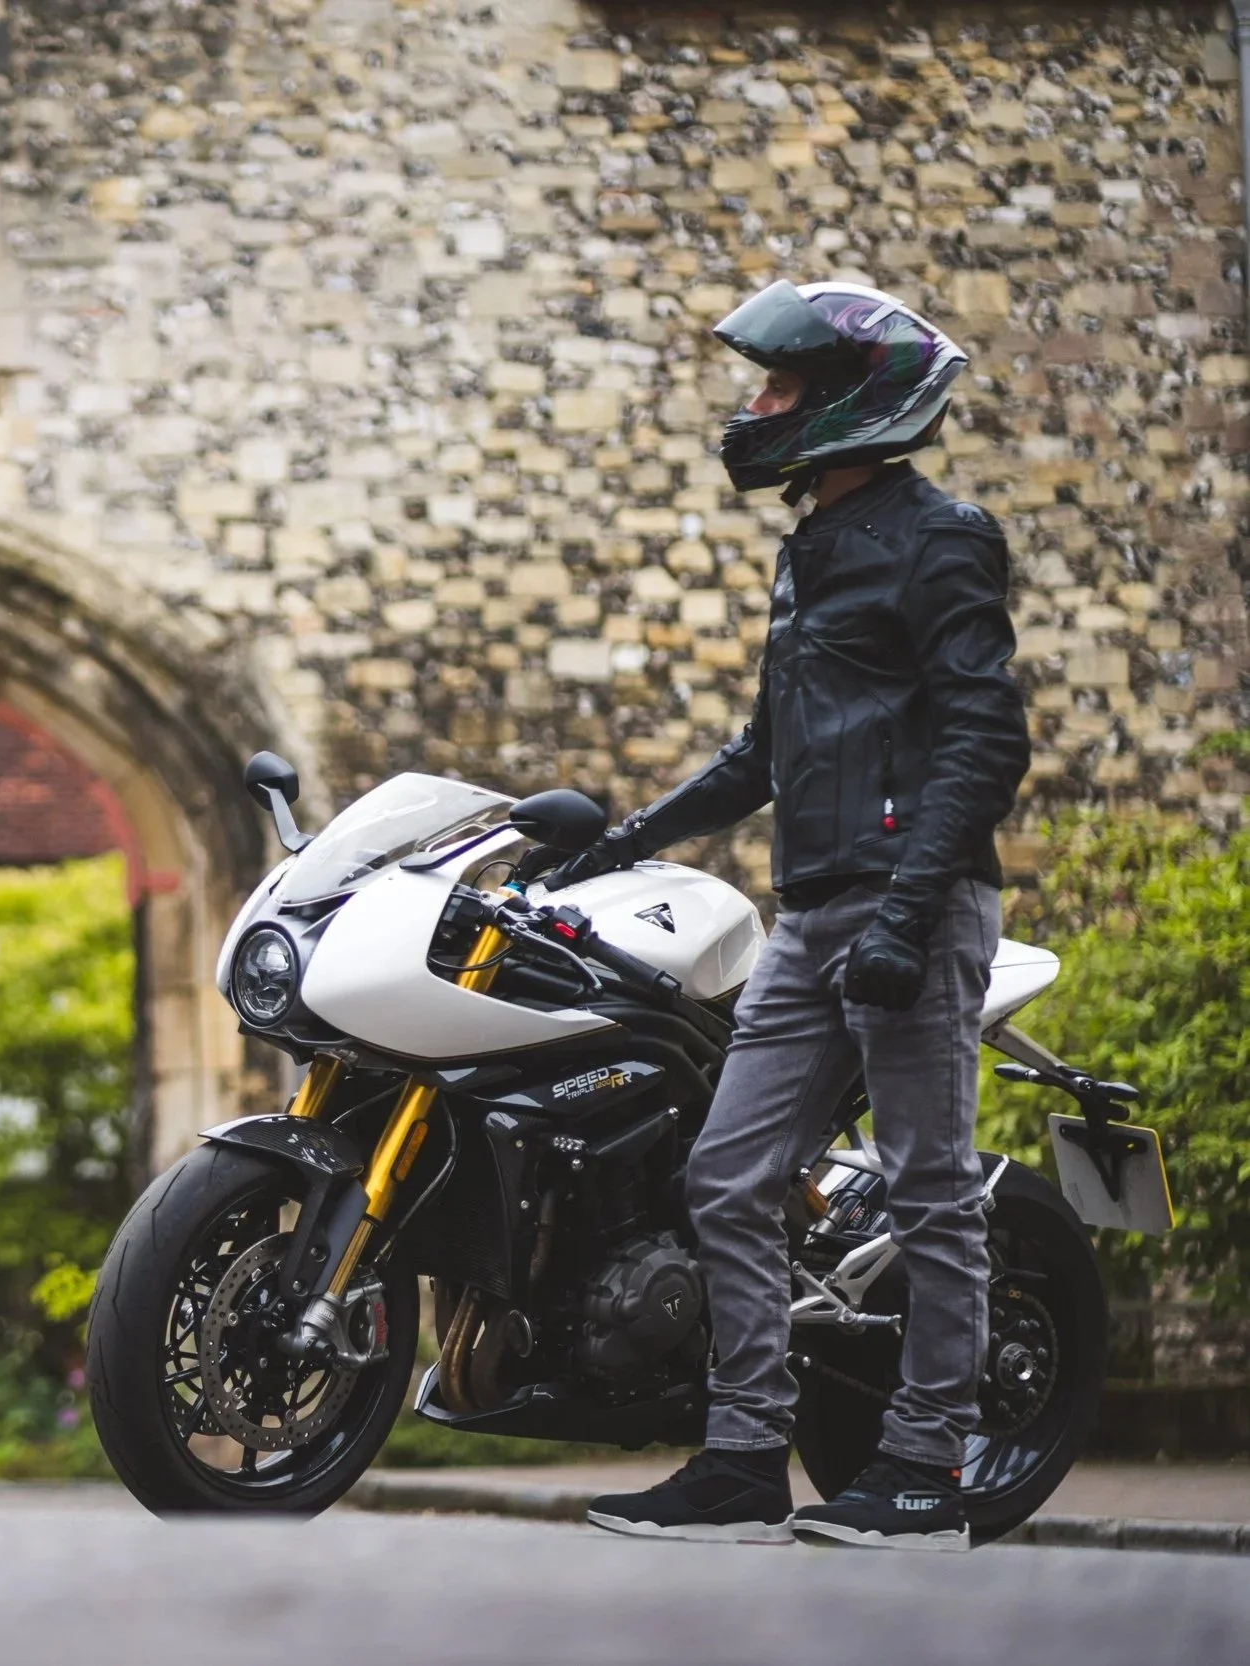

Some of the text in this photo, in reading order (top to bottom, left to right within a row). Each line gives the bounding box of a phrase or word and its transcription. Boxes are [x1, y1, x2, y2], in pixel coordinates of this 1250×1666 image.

[552, 1067, 610, 1099] SPEED
[565, 1085, 595, 1101] TRIPLE
[595, 1078, 611, 1090] 1200
